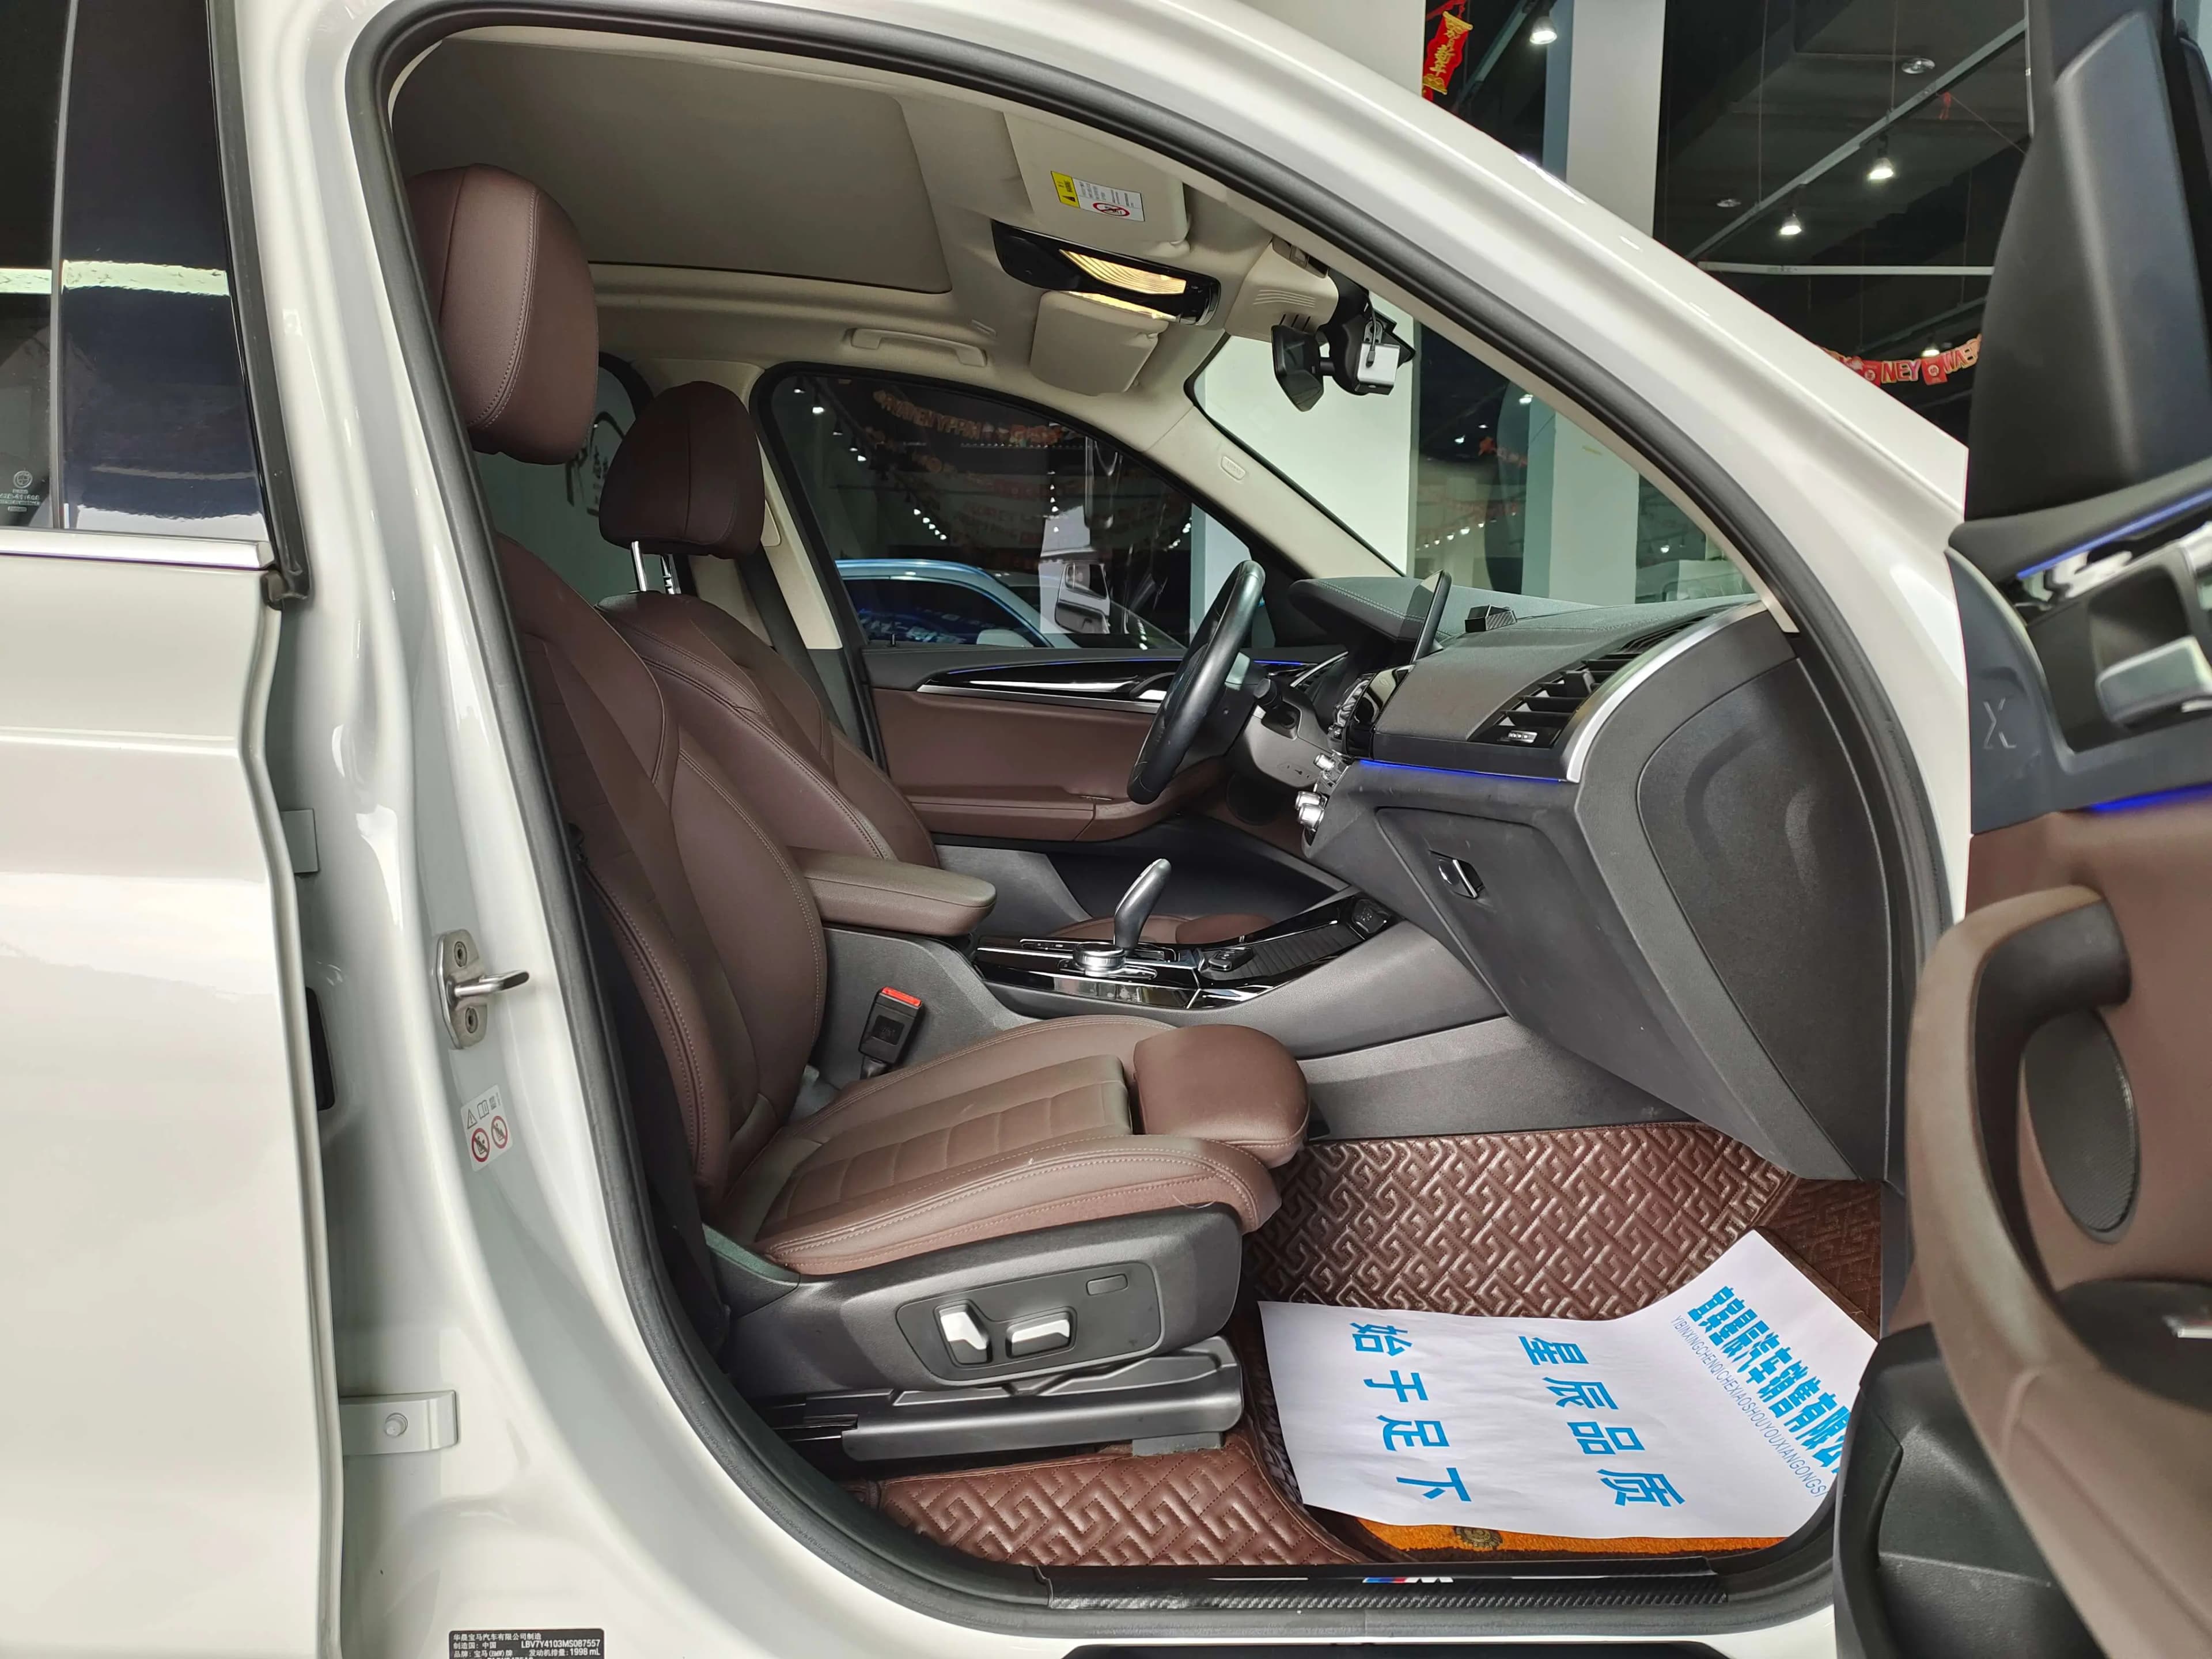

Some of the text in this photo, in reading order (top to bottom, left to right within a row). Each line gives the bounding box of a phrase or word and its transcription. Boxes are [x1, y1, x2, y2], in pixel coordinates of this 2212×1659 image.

[1351, 1322, 1471, 1502] 始于足下
[1519, 1336, 1685, 1508] 星辰品质
[1687, 1286, 1851, 1475] 宜宾星辰汽车销售有限公
[521, 1639, 600, 1648] LBV7Y4103MS087557
